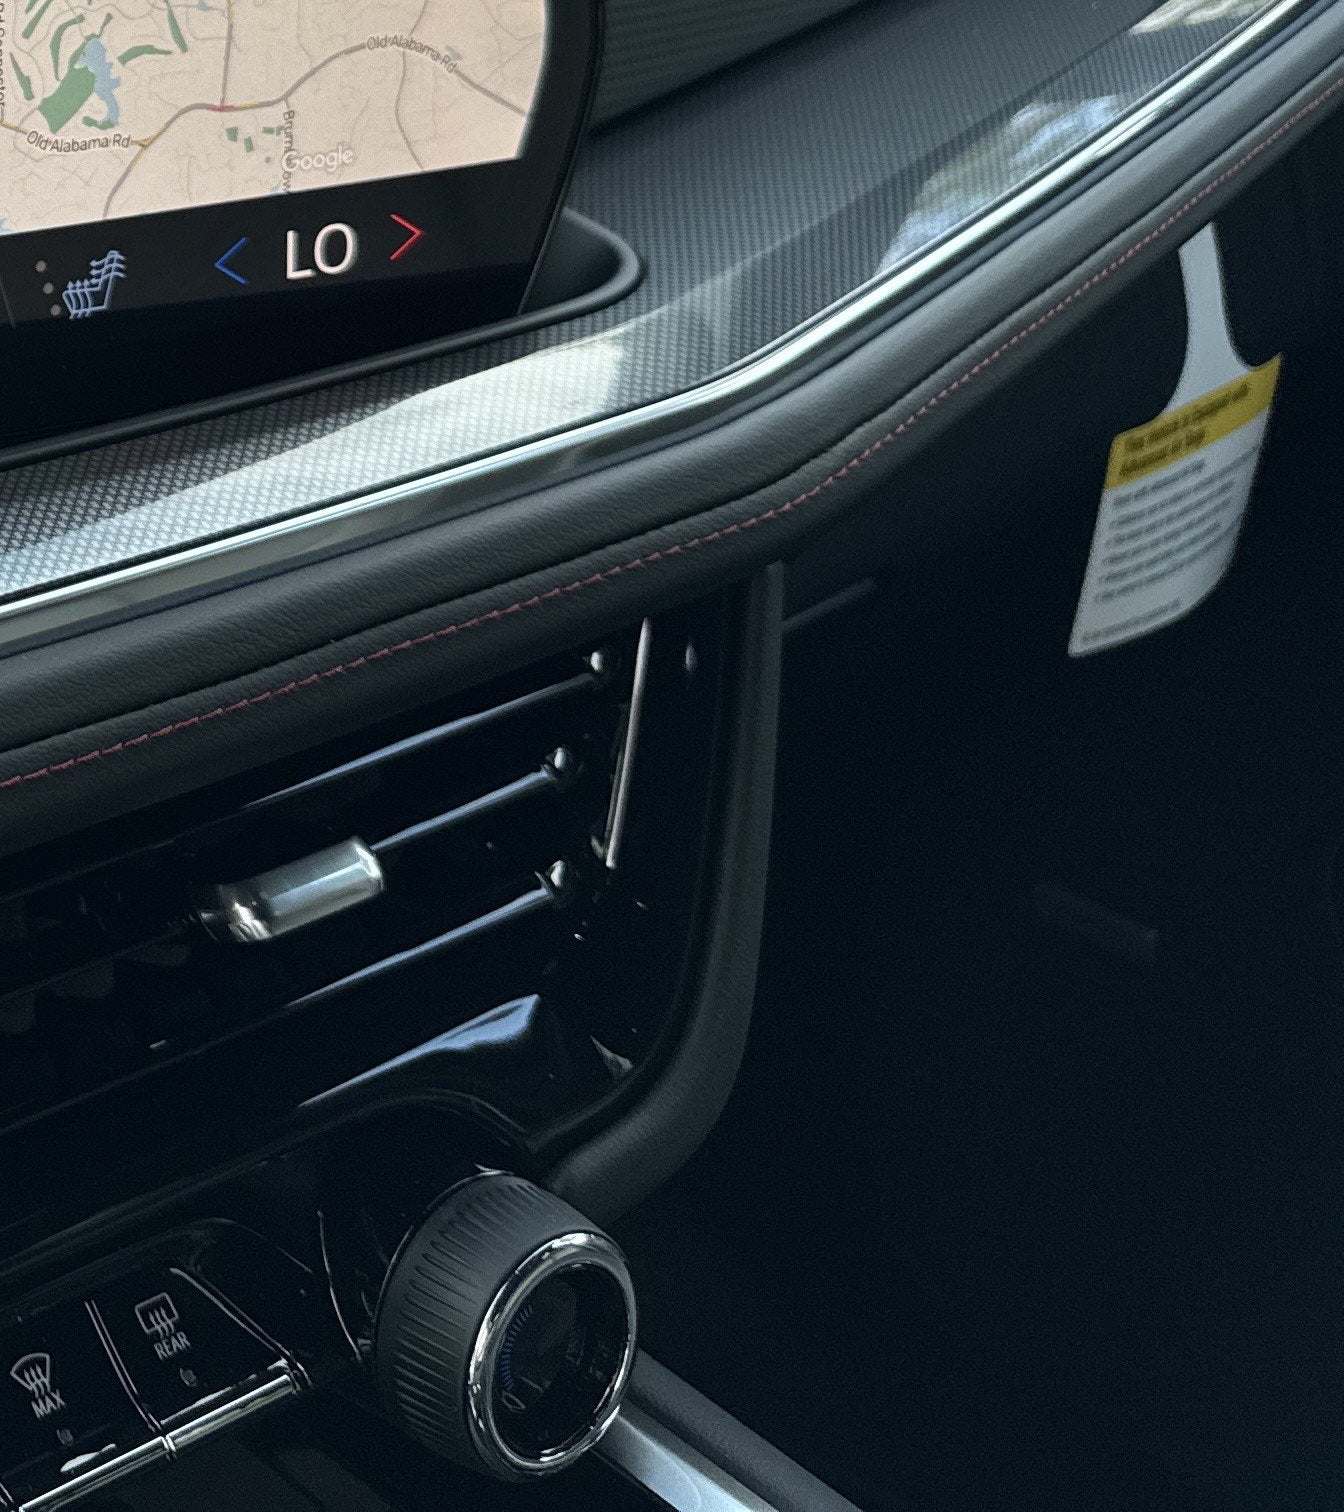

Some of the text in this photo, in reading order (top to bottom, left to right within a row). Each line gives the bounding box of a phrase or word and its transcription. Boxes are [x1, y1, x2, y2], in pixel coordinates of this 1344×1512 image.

[366, 35, 459, 73] Old Alabama Rd
[27, 131, 131, 153] Old Alabama Rd
[282, 144, 353, 173] Google
[285, 222, 357, 281] LO
[154, 1332, 190, 1360] REAR
[31, 1389, 65, 1419] MAX
